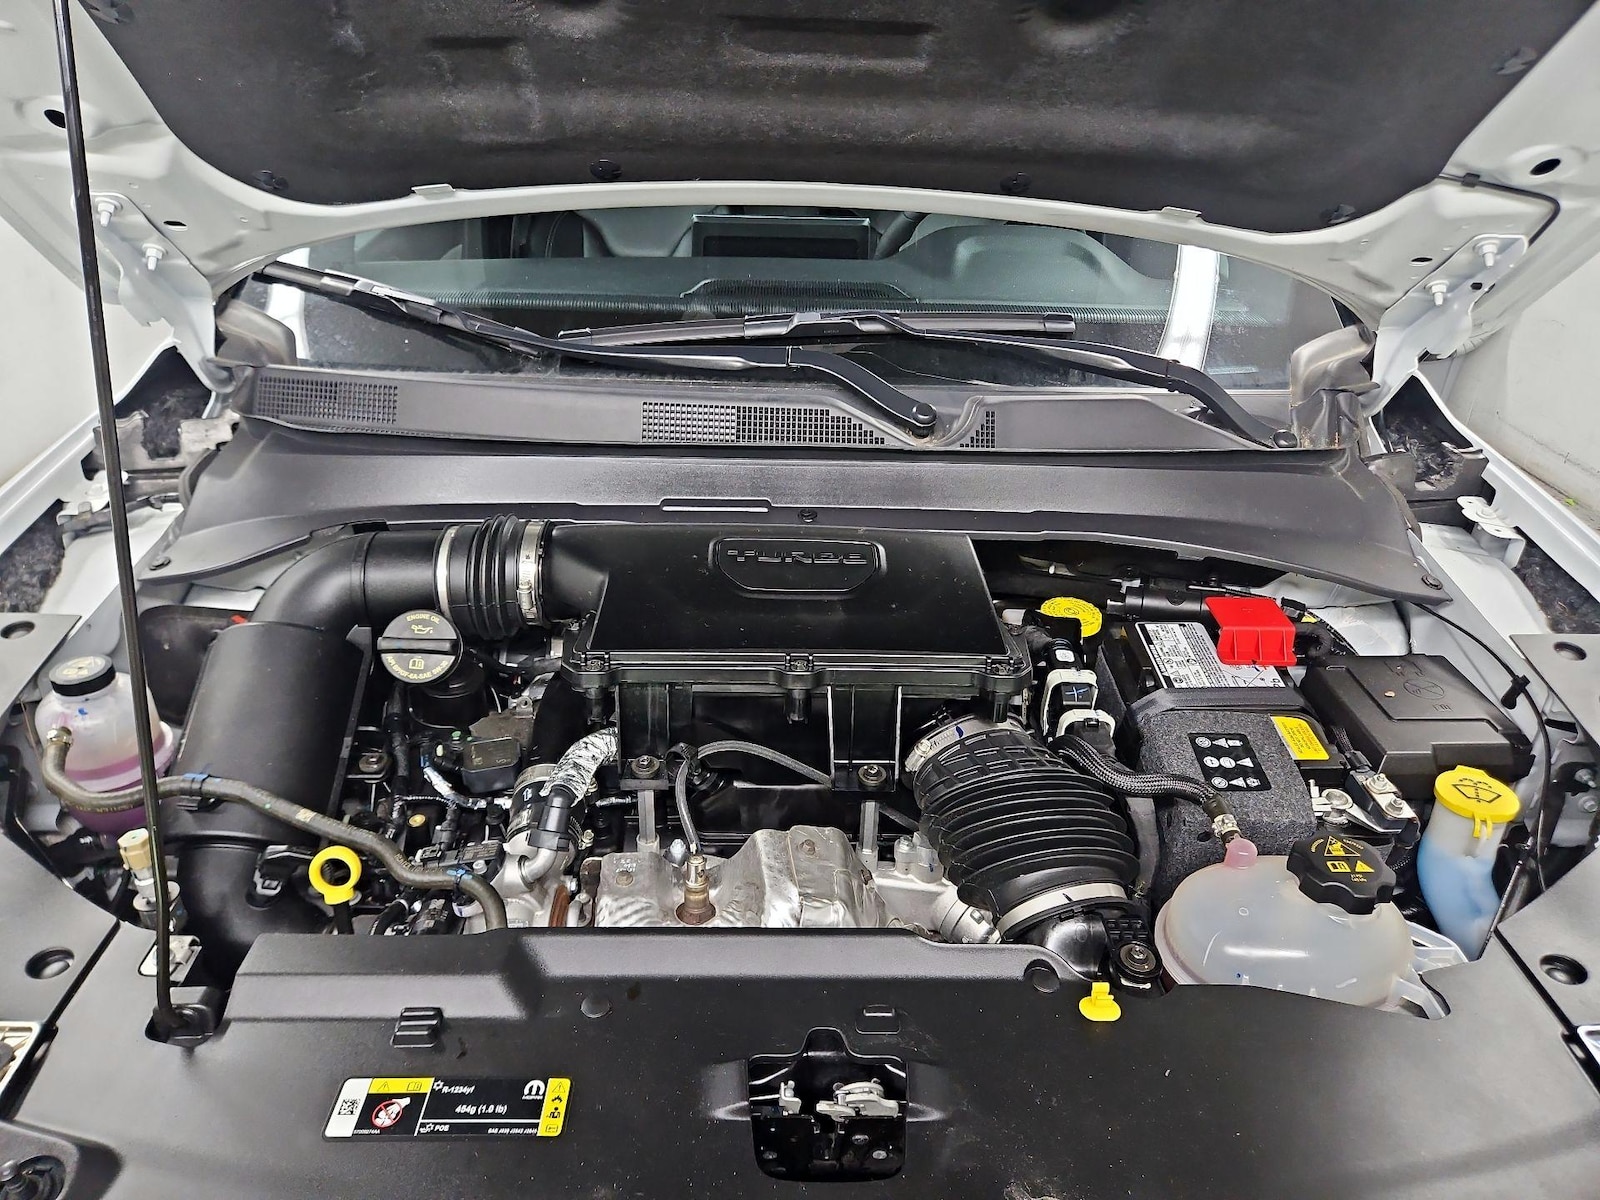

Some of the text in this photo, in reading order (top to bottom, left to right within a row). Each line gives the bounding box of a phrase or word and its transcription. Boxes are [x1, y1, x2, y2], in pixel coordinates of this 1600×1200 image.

[727, 550, 868, 565] TURBO
[406, 613, 440, 624] ENGINE OIL
[441, 1085, 476, 1095] R-1234yf
[455, 1104, 507, 1115] 454g (1.0 lb)
